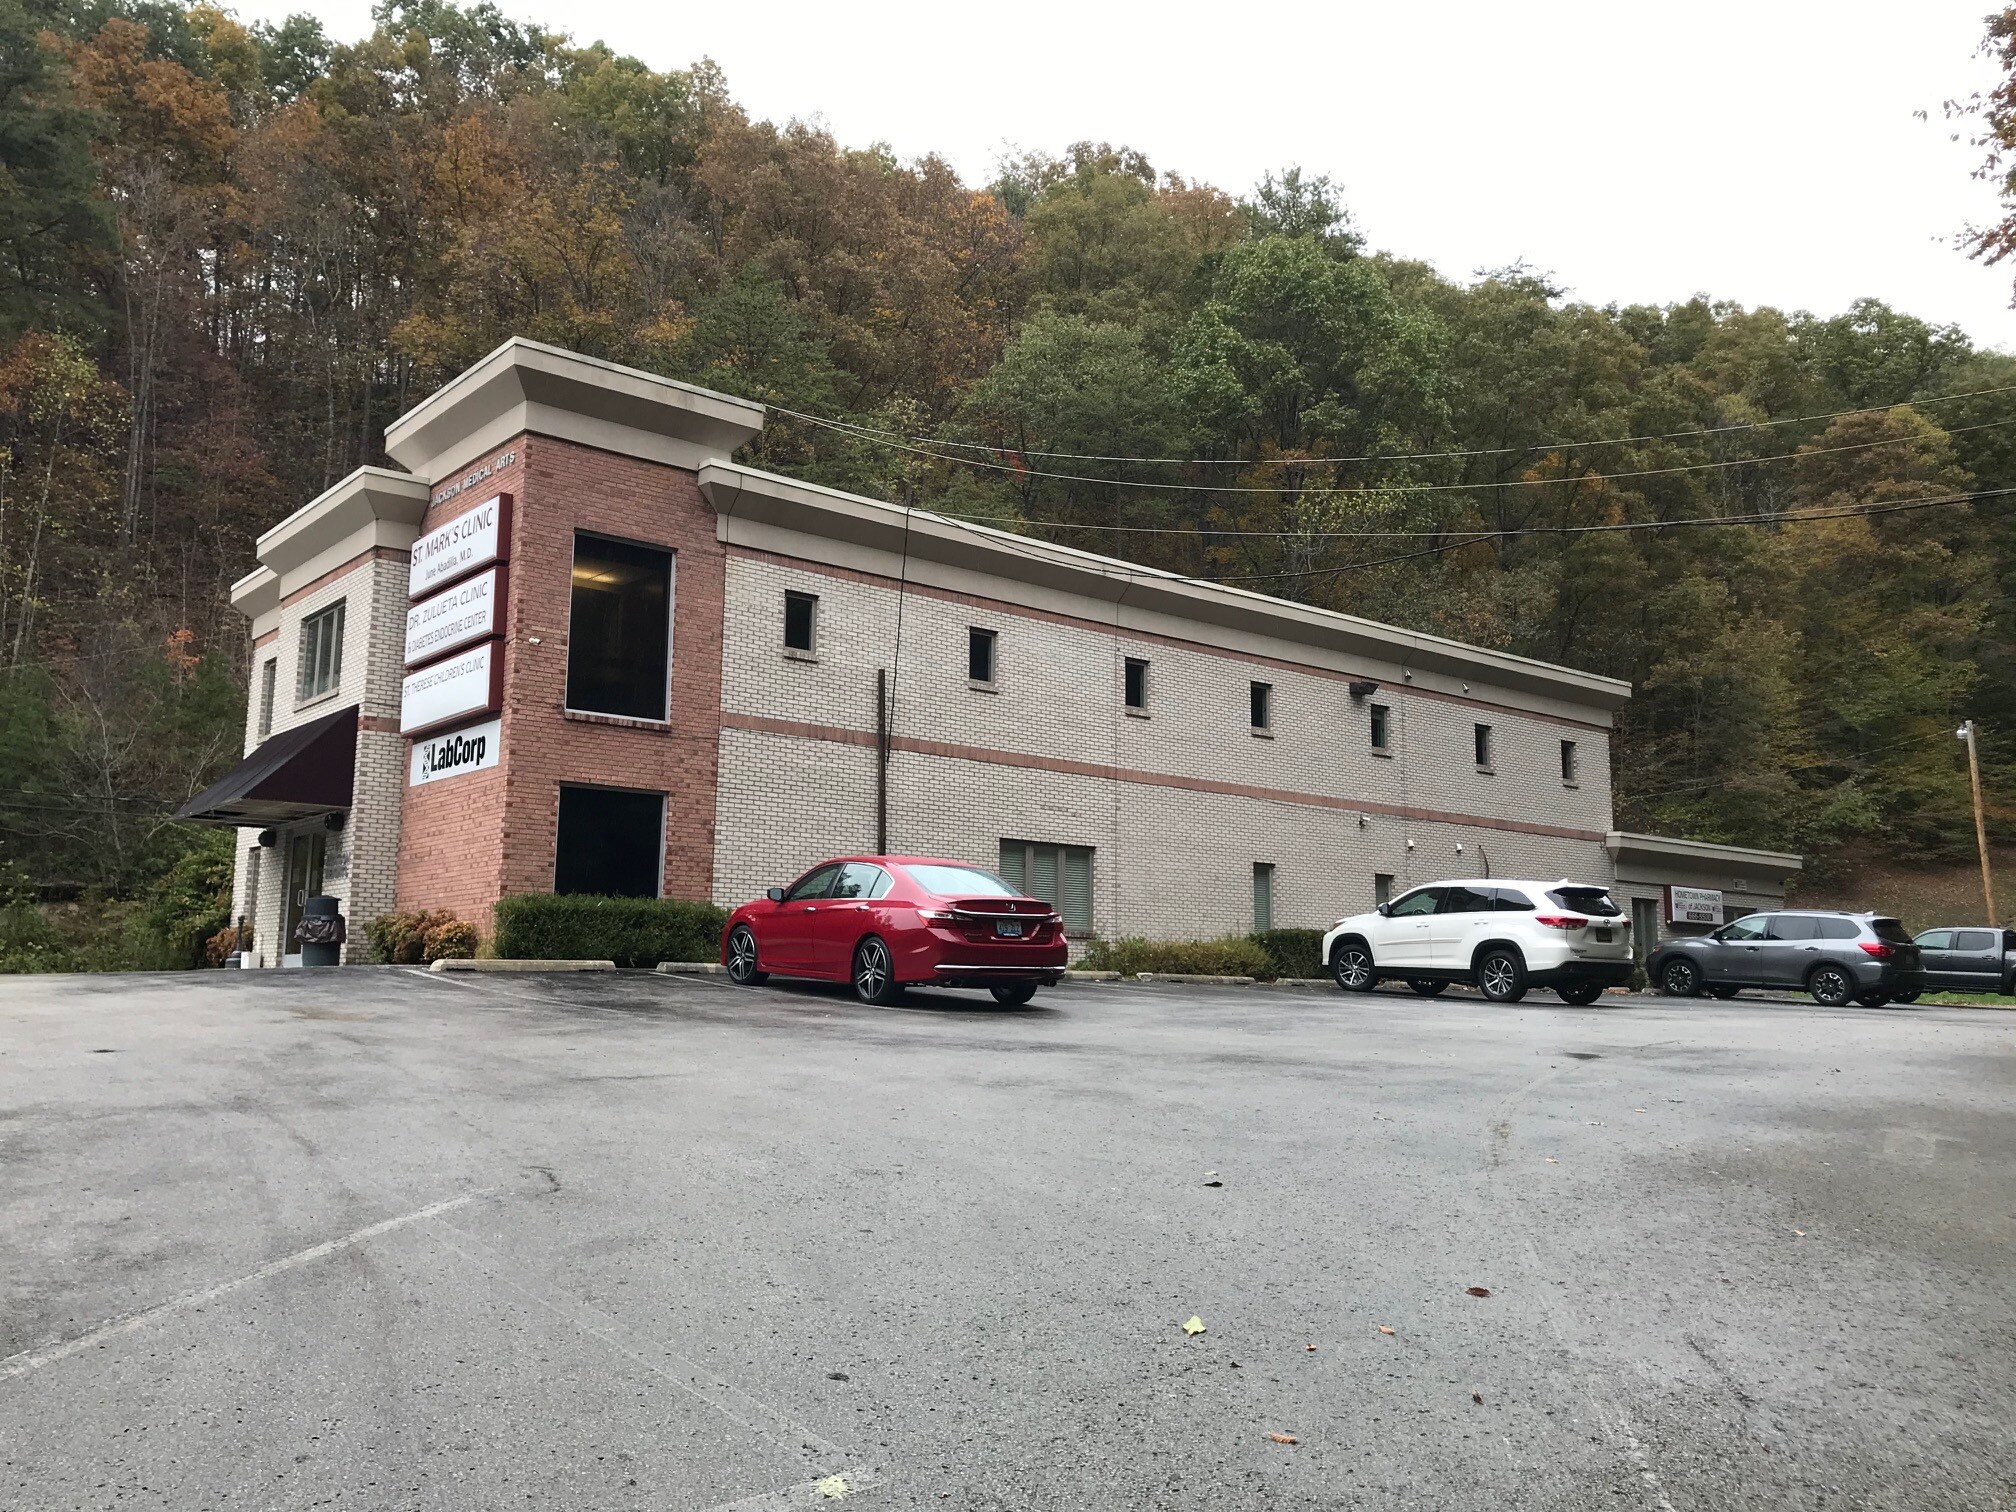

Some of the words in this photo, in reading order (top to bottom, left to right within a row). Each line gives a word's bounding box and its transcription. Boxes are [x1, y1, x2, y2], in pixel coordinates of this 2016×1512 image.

[431, 482, 461, 508] JACKSON
[463, 464, 492, 490] MEDICAL
[496, 451, 515, 471] ARTS
[412, 545, 423, 567] ST.
[425, 525, 460, 560] MARK'S
[461, 507, 493, 539] CLINIC
[425, 567, 436, 580] June
[460, 547, 474, 562] M.D.
[422, 595, 458, 624] ZULUETA
[460, 581, 488, 606] CLINIC
[411, 632, 434, 652] DIABETES
[434, 619, 463, 642] ENDOCRINE
[463, 610, 487, 630] CENTER
[411, 675, 434, 694] THERESE
[434, 662, 466, 686] CHILDREN'S
[466, 656, 485, 674] CLINIC
[430, 735, 486, 772] LabCorp
